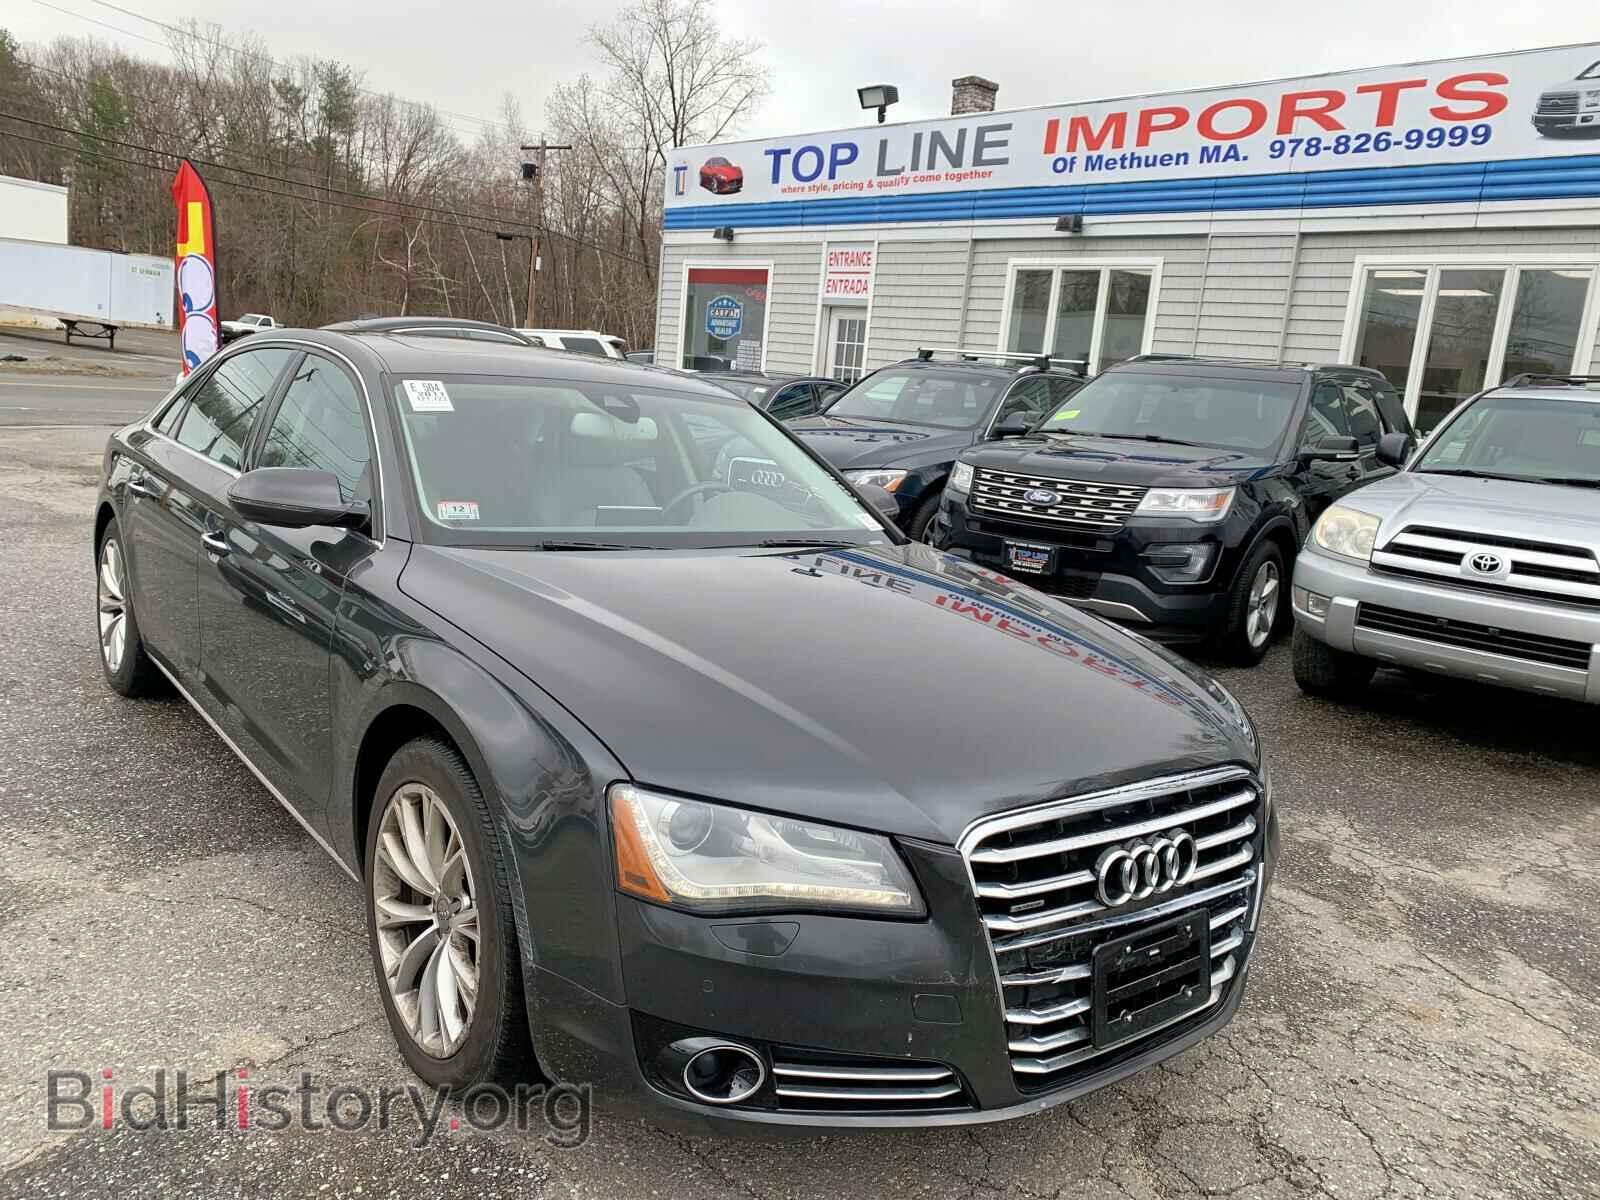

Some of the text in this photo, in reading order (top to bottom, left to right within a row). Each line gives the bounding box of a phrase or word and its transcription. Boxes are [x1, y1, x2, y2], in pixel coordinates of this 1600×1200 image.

[1044, 72, 1509, 154] IMPORTS
[764, 122, 1013, 185] TOP LINE
[1052, 123, 1492, 173] Of Methuen MA. 978-826-9999
[781, 169, 993, 194] where style, pricing & quality come together
[828, 251, 872, 267] ENTRANCE
[826, 279, 869, 294] ENTRADA
[409, 382, 416, 393] E
[452, 505, 464, 513] 12
